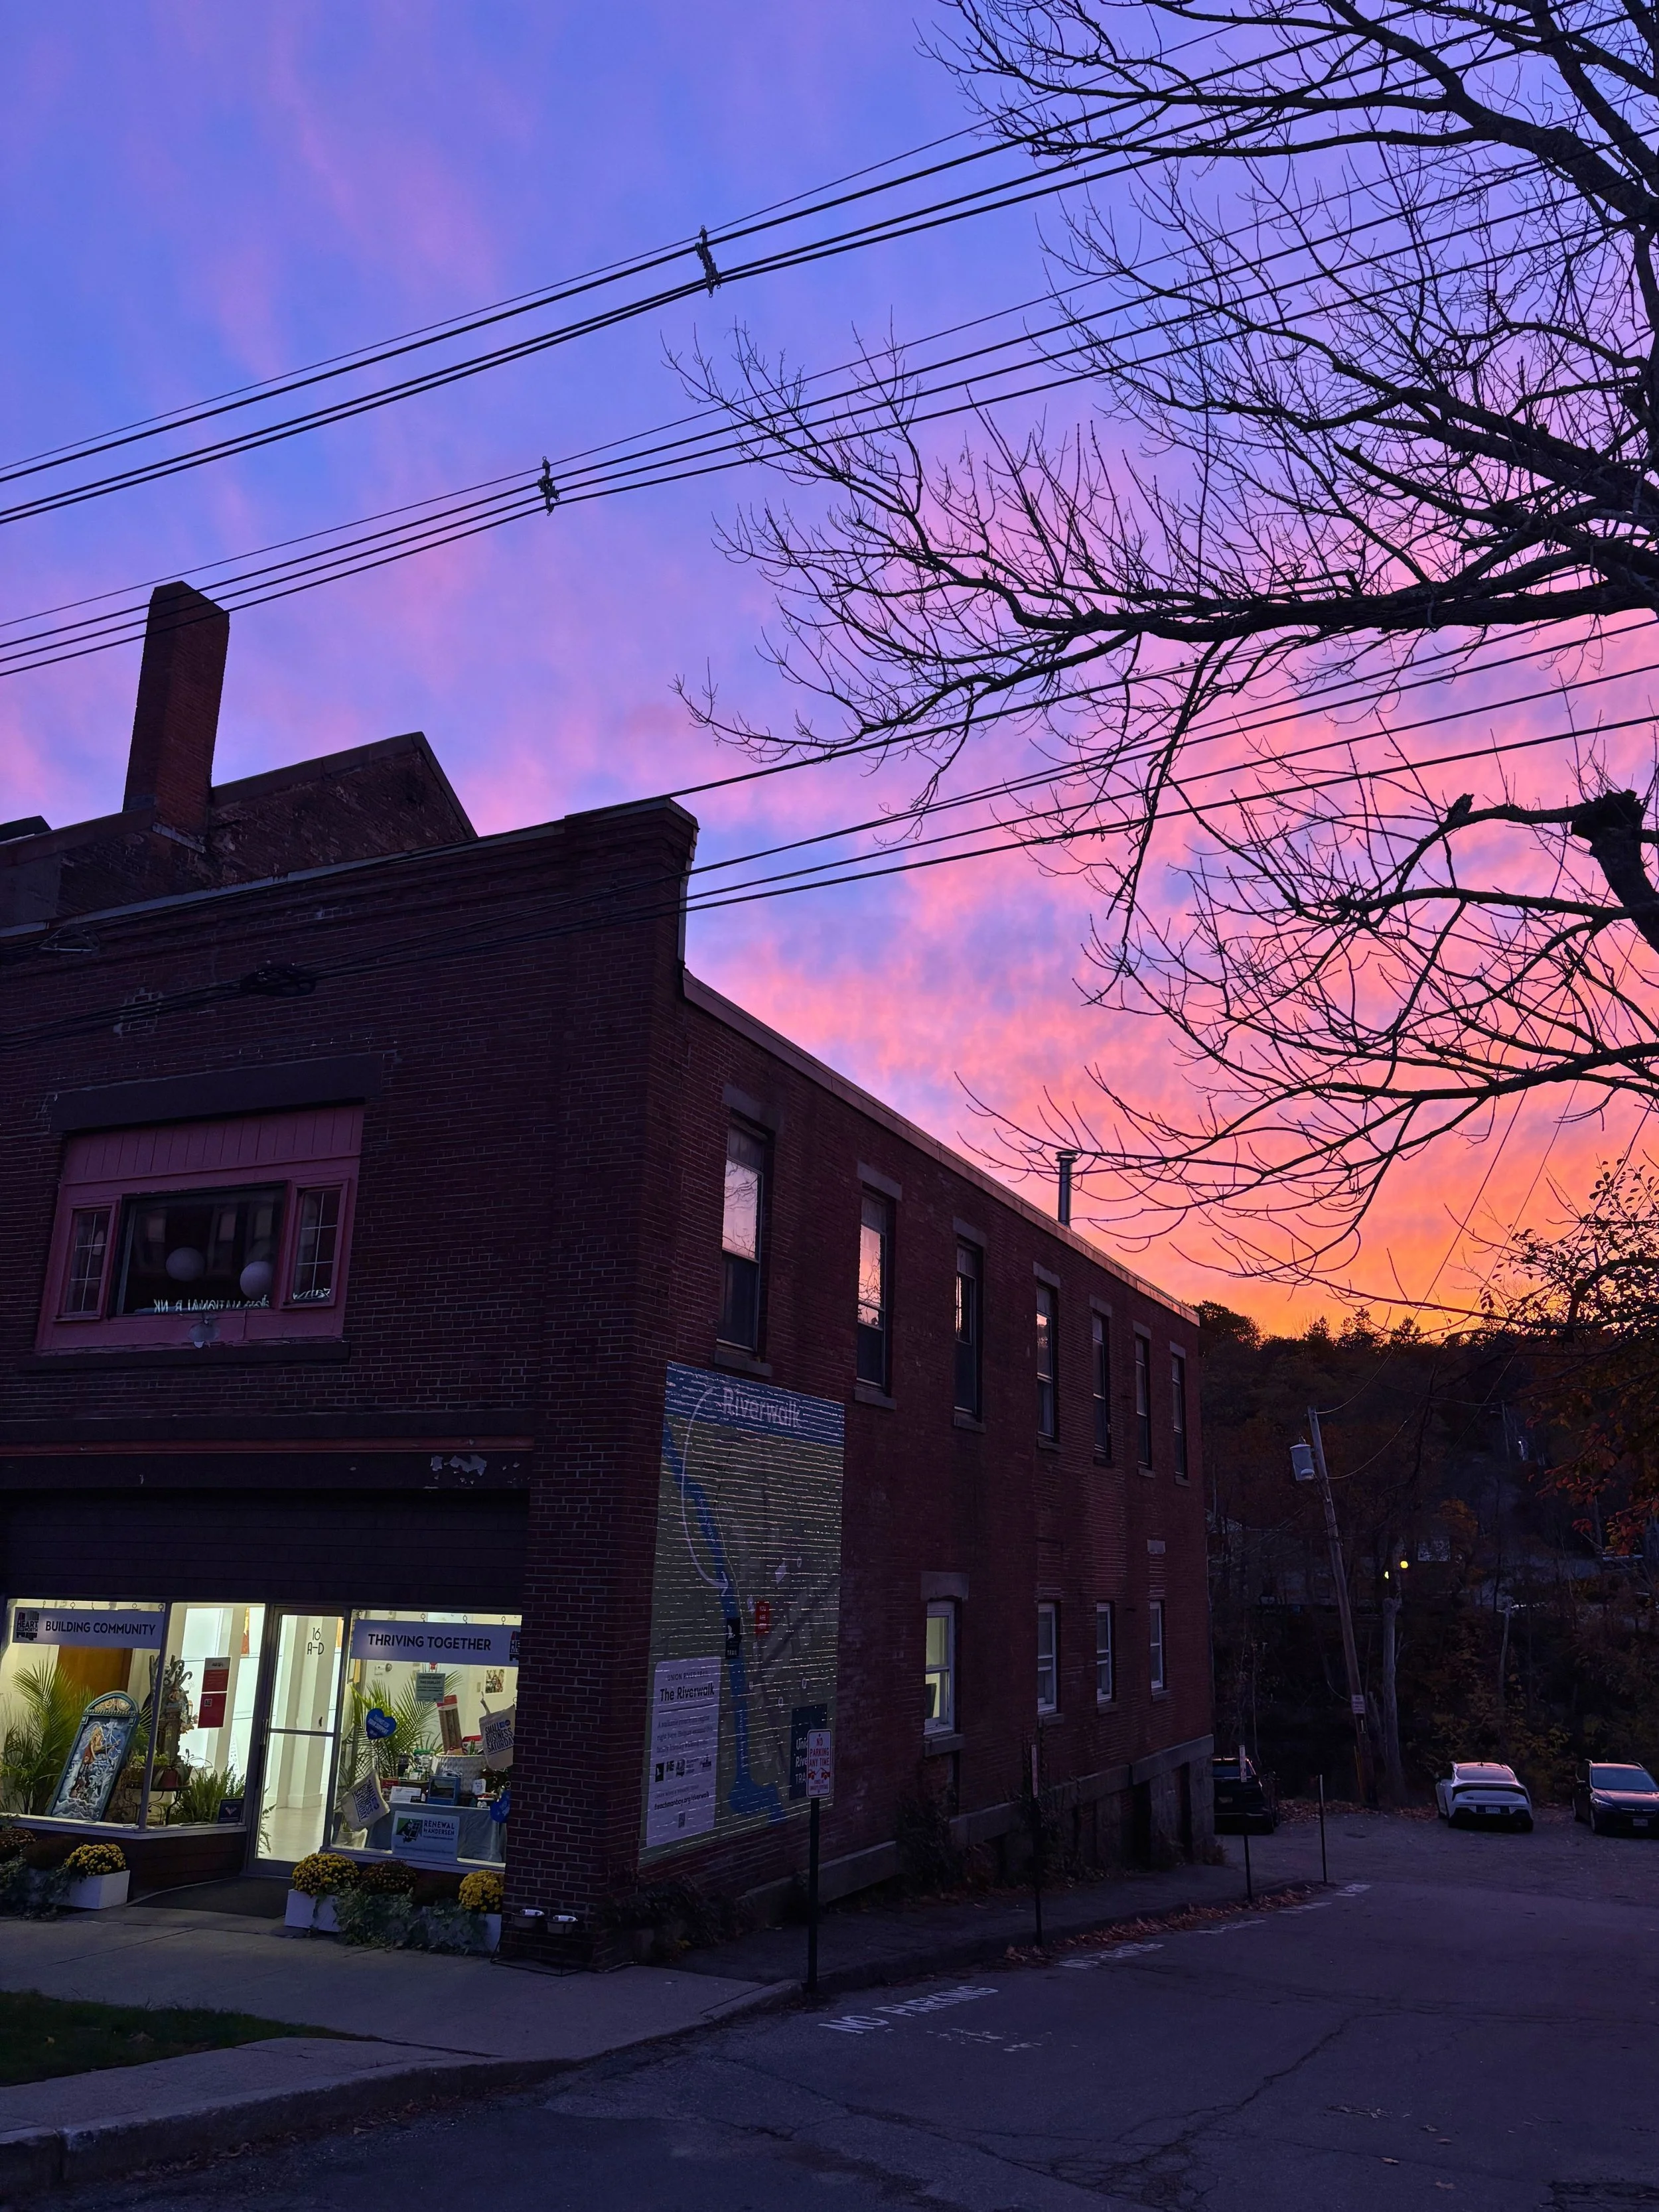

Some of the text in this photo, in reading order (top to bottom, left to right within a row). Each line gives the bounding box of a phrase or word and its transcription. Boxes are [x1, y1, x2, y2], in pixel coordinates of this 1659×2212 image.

[723, 1387, 800, 1427] Riverwalk
[45, 1621, 156, 1635] BUILDING COMMUNITY
[313, 1627, 321, 1640] 16
[307, 1642, 325, 1655] A-D
[368, 1633, 491, 1651] THRIVING TOGETHER
[660, 1683, 715, 1701] The Riverwalk
[484, 1723, 500, 1737] SMALL
[485, 1728, 513, 1744] BUSINESS
[817, 1738, 823, 1746] NO
[810, 1748, 829, 1757] PARKING
[810, 1757, 830, 1766] ANY TIME
[424, 1820, 455, 1830] RENEWAL
[818, 1986, 999, 2034] NO PARKING
